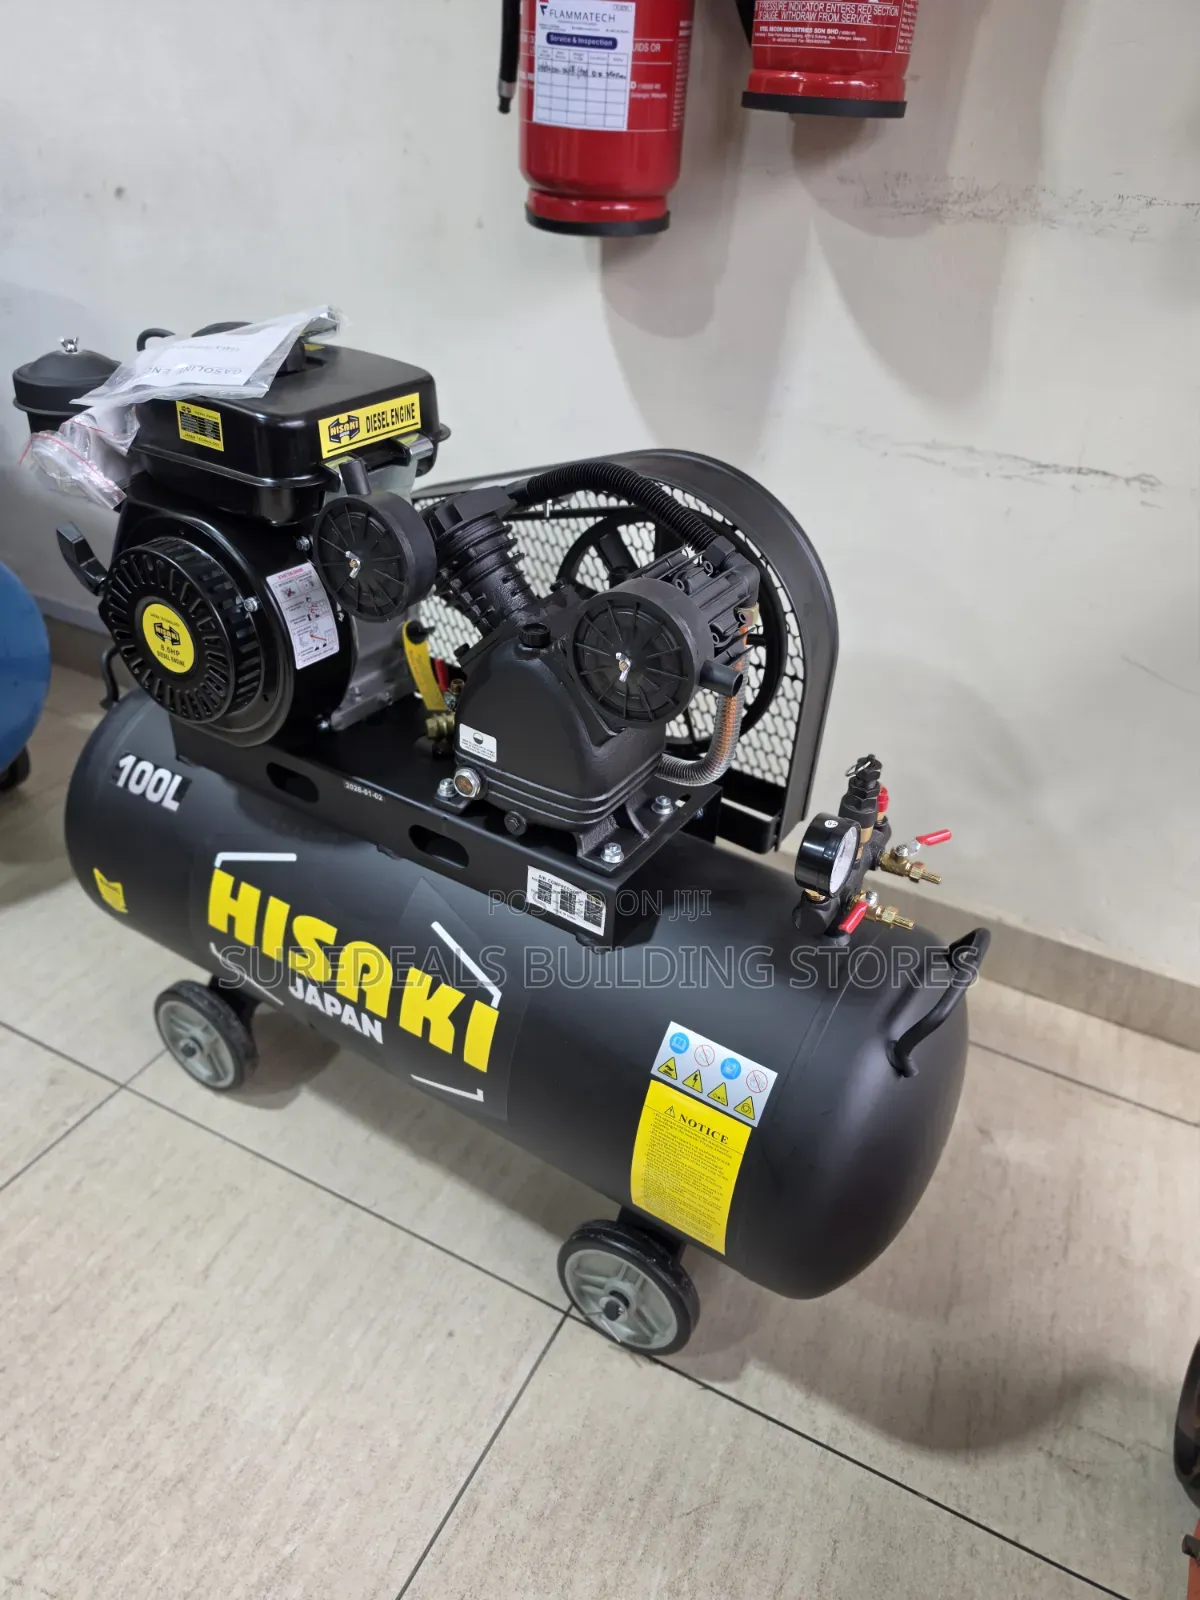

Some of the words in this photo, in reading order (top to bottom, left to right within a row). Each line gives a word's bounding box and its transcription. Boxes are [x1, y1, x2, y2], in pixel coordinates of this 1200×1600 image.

[549, 9, 616, 23] FLAMMATECH
[781, 11, 816, 21] WITHDRAW
[818, 12, 840, 22] FROM
[788, 2, 824, 12] INDICATOR
[826, 4, 855, 14] ENTERS
[857, 6, 872, 15] RED
[873, 6, 899, 17] SECTION
[549, 34, 571, 43] Service
[578, 36, 613, 46] Inspection
[650, 43, 661, 53] OR
[177, 364, 242, 375] GASOLINE
[330, 420, 359, 436] HISAKI
[366, 411, 390, 433] DIESEL
[390, 403, 415, 425] ENGINE
[116, 754, 183, 812] 100L
[208, 867, 499, 1073] HISAKI
[287, 976, 383, 1044] JAPAN
[678, 1113, 729, 1145] NOTICE
